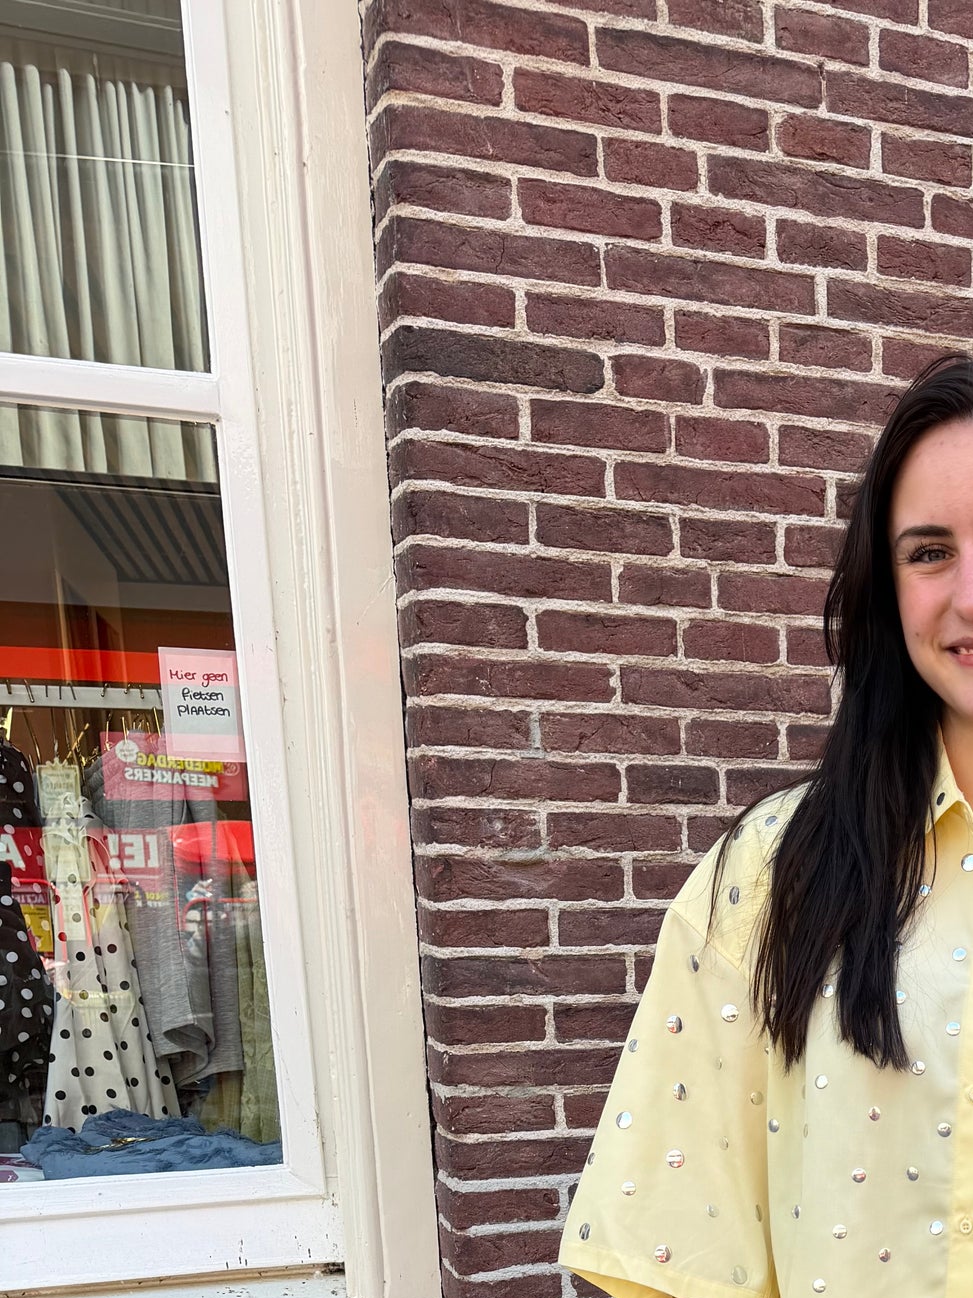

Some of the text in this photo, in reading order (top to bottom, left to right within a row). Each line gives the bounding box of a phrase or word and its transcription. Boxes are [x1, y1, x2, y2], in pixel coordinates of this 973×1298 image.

[169, 668, 229, 688] Hier geen
[181, 687, 225, 702] fietsen
